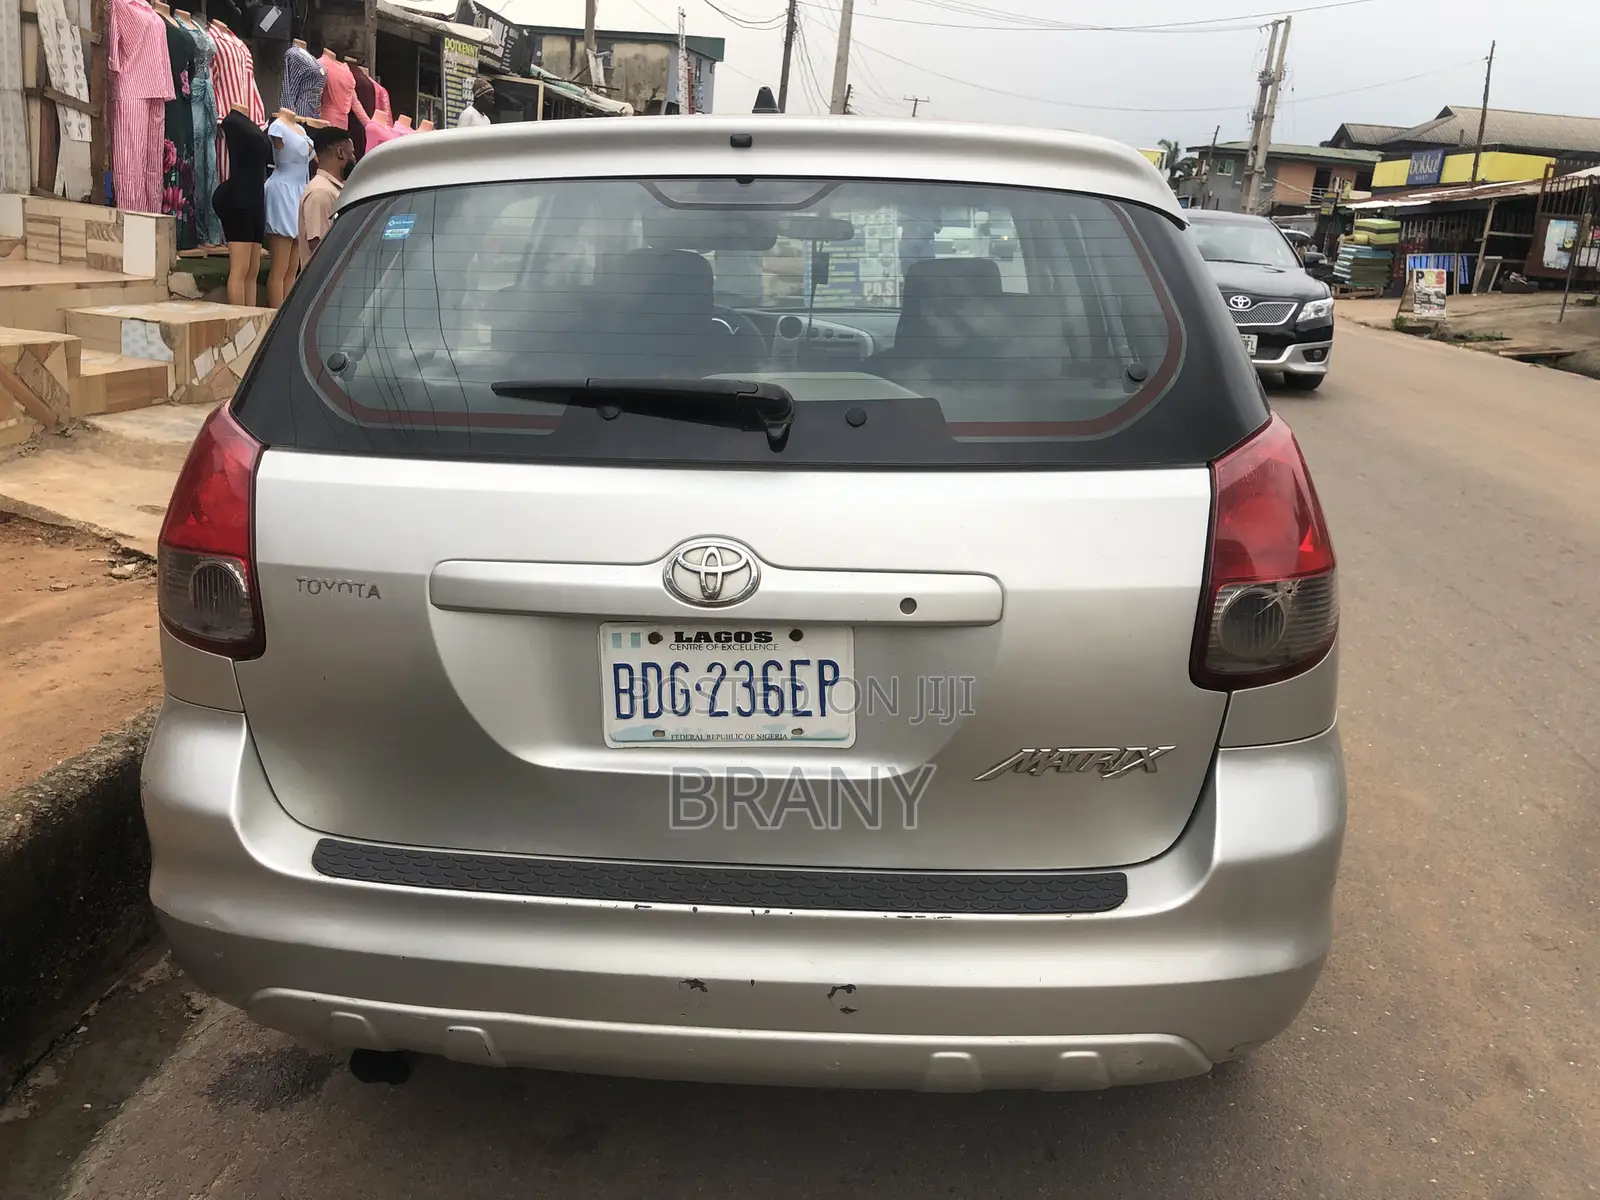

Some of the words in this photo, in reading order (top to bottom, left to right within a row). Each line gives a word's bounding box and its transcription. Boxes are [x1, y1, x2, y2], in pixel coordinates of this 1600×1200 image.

[1415, 270, 1446, 285] POS
[296, 577, 382, 600] TOYOTA
[673, 631, 774, 644] LAGOS
[668, 643, 703, 651] CENTRE
[705, 643, 719, 651] OF
[721, 643, 779, 651] EXCELLENCE
[670, 733, 706, 741] FEDERAL
[706, 733, 743, 741] REPUBLIC
[744, 733, 754, 741] OF
[756, 733, 788, 741] NIGERIA
[972, 745, 1177, 782] MATRIX
